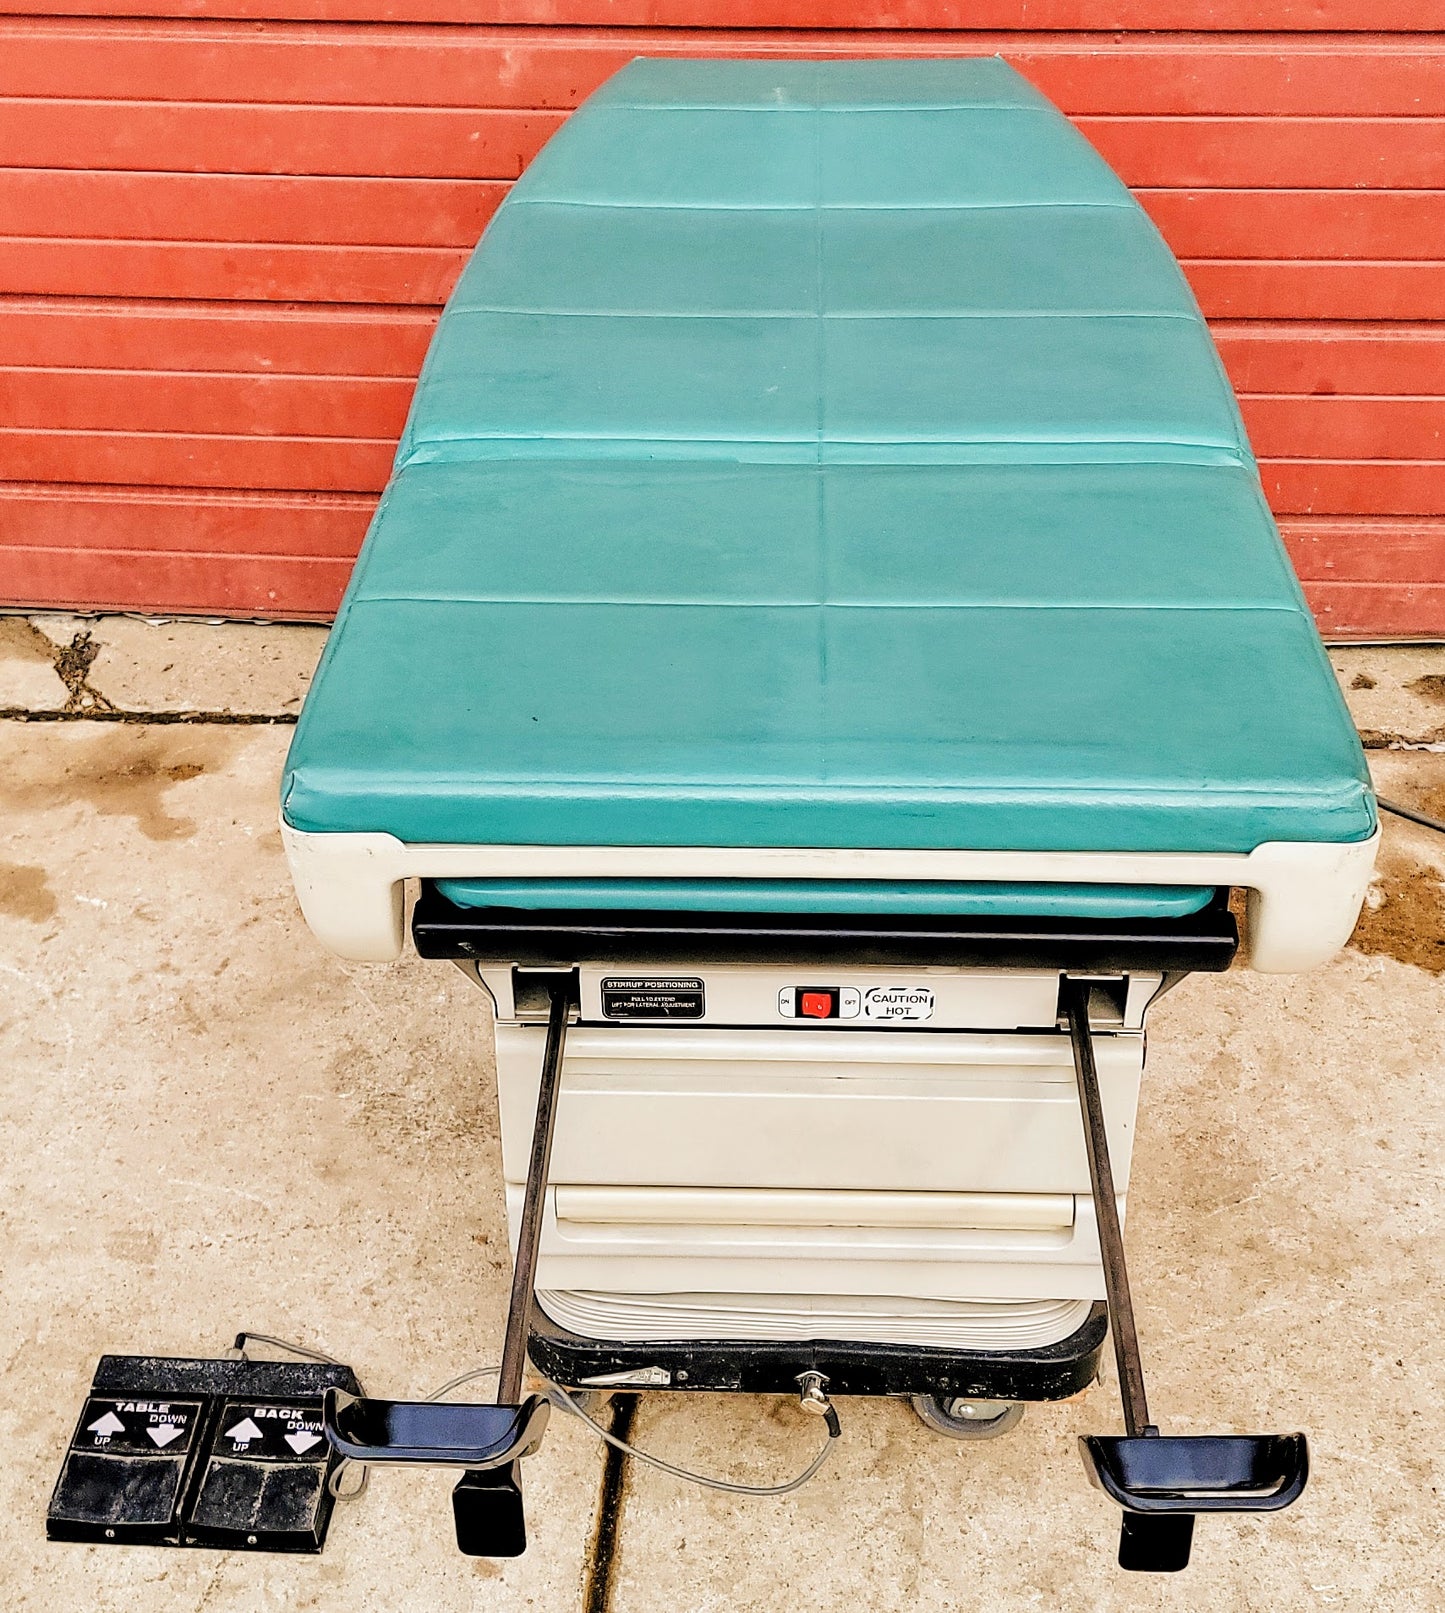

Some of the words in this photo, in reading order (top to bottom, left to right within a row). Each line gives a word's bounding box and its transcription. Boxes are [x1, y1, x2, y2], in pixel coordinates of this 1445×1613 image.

[872, 994, 928, 1004] CAUTION
[886, 1007, 912, 1015] HOT
[116, 1402, 172, 1414] TABLE
[150, 1414, 188, 1424] DOWN
[254, 1408, 304, 1420] BACK
[286, 1420, 324, 1431] DOWN
[94, 1436, 111, 1446] UP
[232, 1442, 250, 1452] UP
